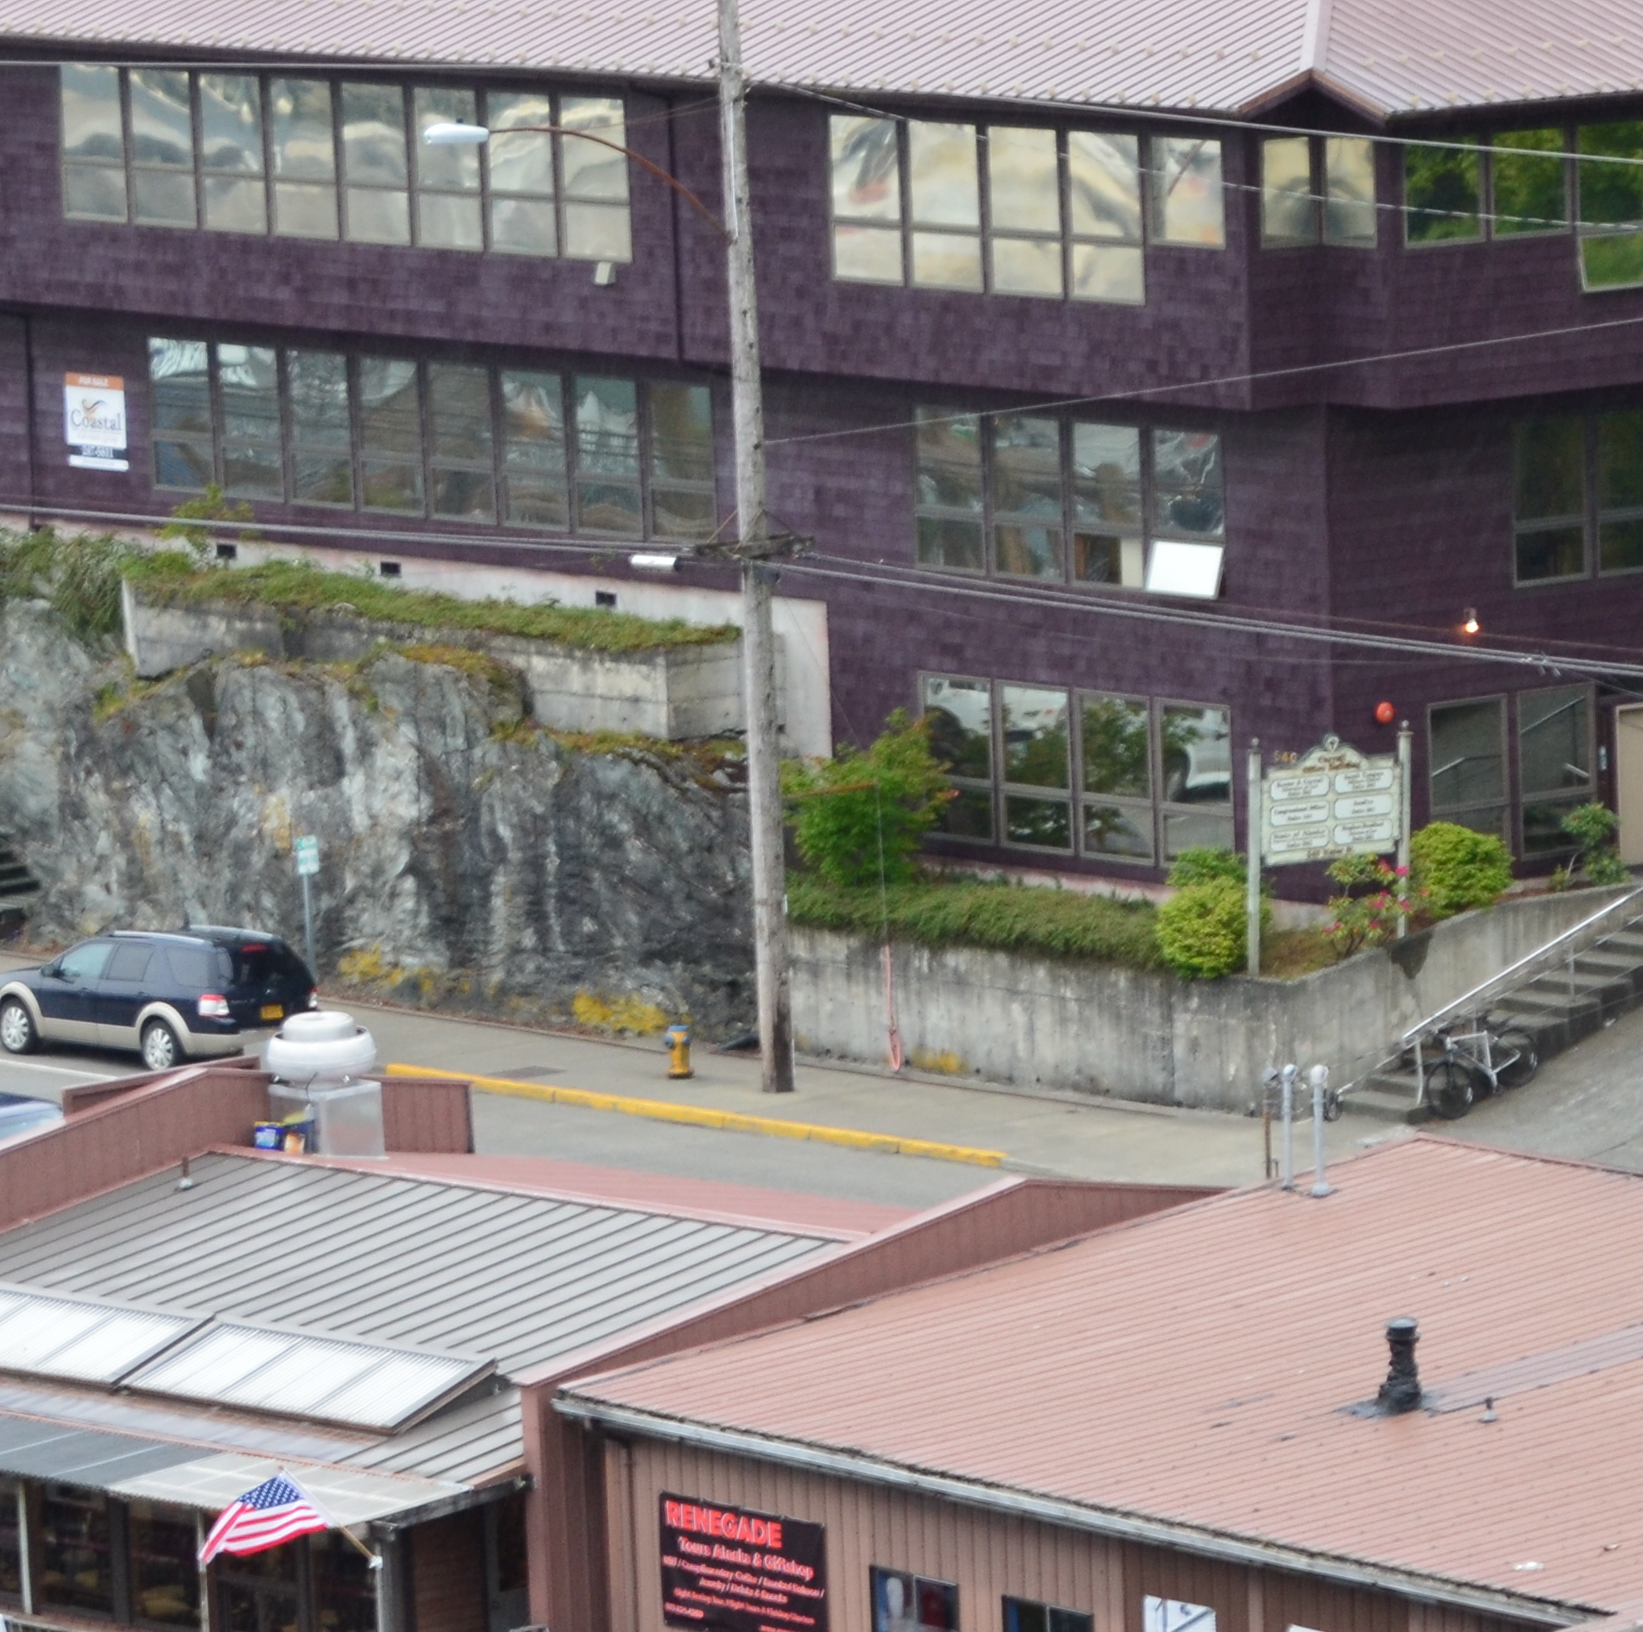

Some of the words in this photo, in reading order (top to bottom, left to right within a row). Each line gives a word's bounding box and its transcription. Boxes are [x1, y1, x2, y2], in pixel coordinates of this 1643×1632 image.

[71, 409, 121, 431] Coastal
[665, 1500, 783, 1549] RENEGADE
[677, 1535, 712, 1557] Tours
[713, 1543, 751, 1565] Alaska
[752, 1552, 762, 1568] &
[764, 1554, 815, 1582] Giftshop
